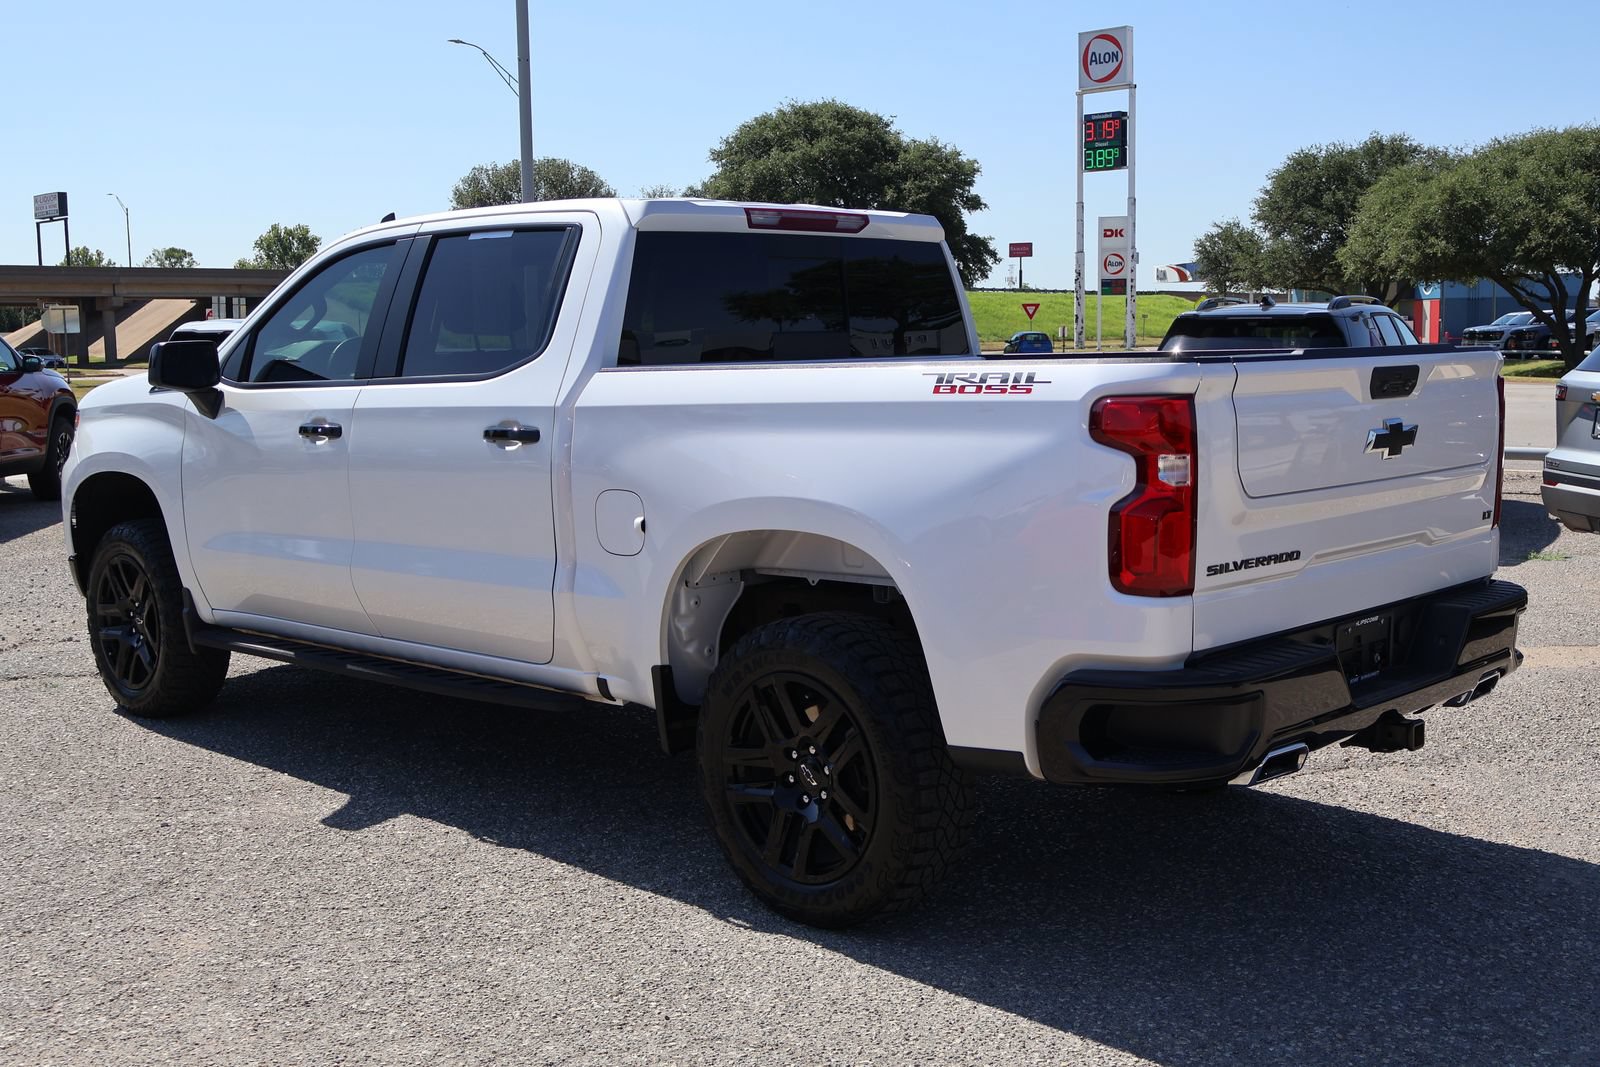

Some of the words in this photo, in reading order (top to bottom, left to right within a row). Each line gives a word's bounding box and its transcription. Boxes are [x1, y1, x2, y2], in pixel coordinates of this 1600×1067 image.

[1089, 50, 1119, 66] ALON
[1103, 228, 1124, 238] DK
[922, 372, 1052, 384] TRAIL
[932, 384, 1033, 394] BOSS
[1482, 510, 1492, 520] LT
[1206, 550, 1301, 577] SILVERADO
